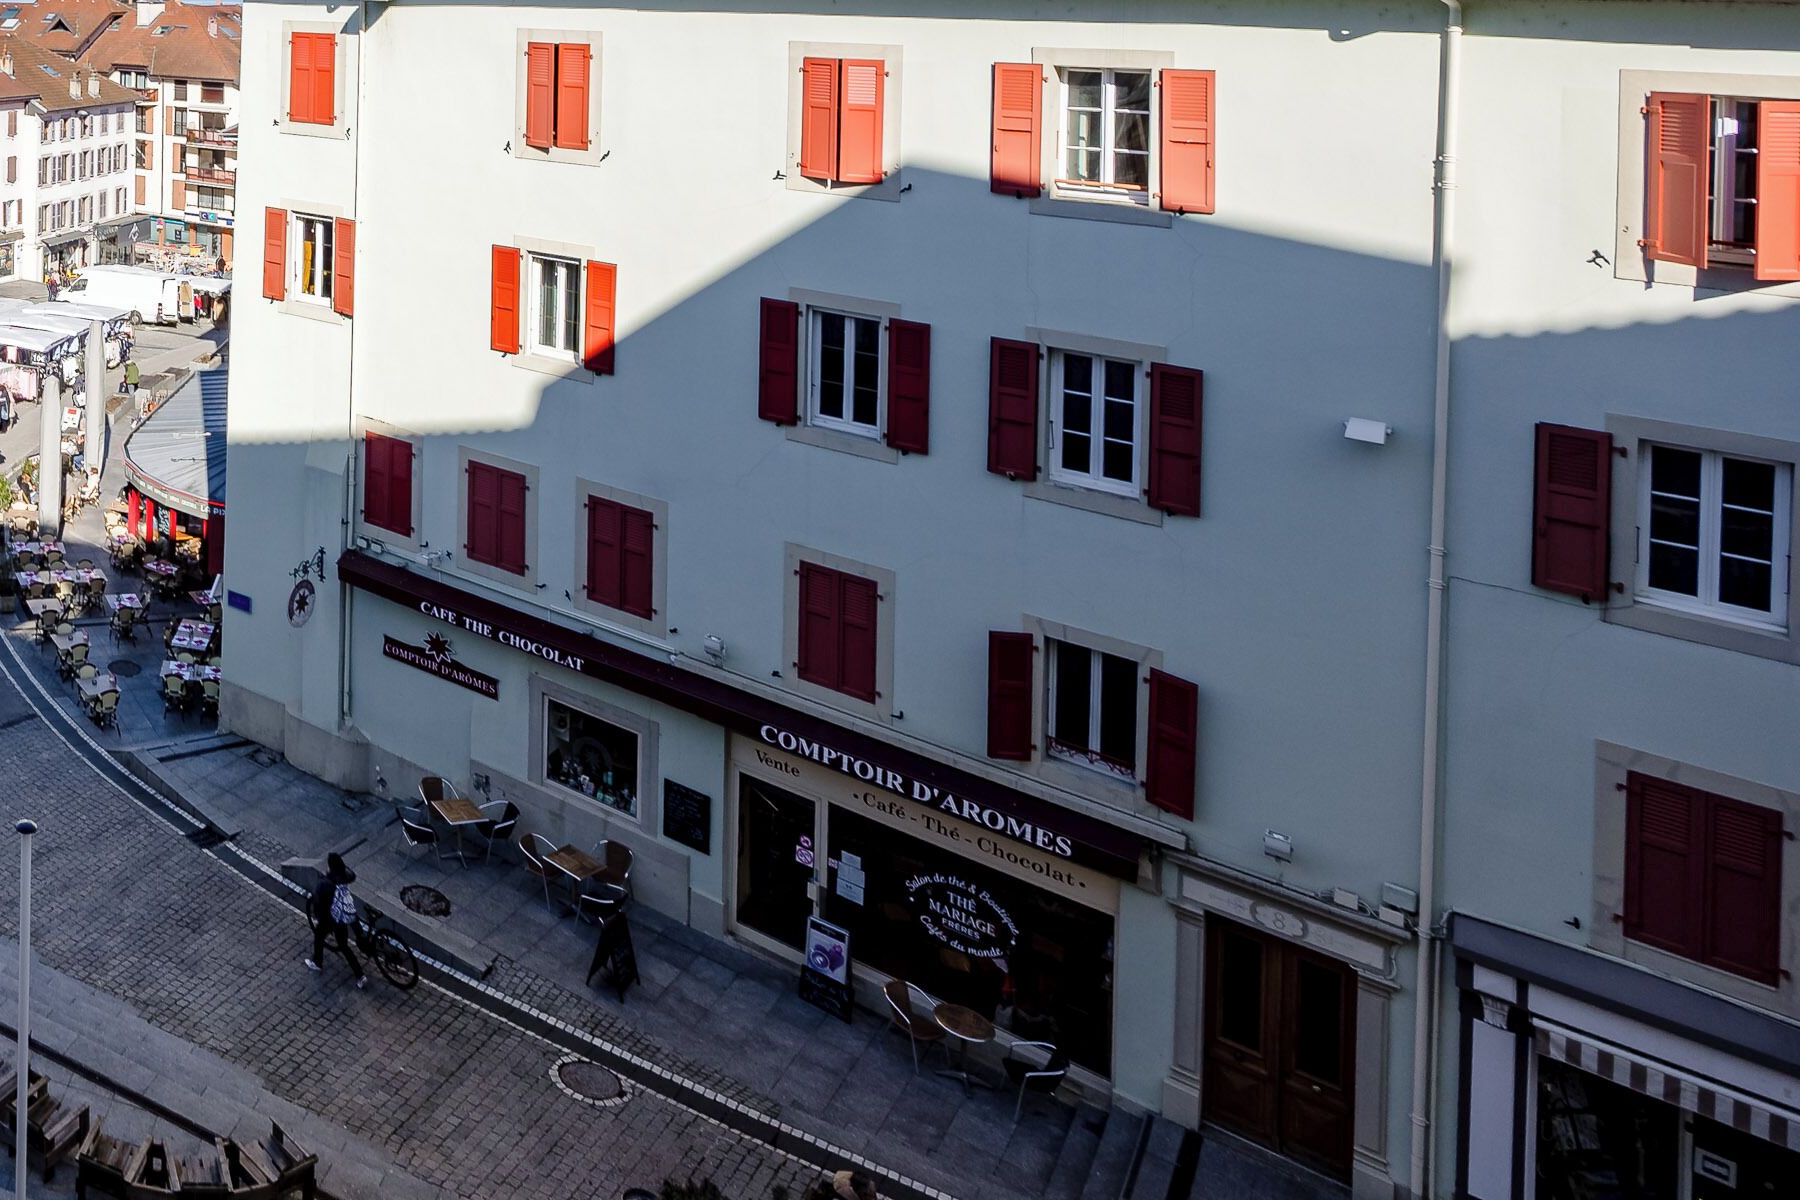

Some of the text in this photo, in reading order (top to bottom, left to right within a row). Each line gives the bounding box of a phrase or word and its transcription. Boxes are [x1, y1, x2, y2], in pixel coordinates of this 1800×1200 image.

[200, 504, 210, 513] LA
[419, 600, 585, 672] CAFE THE CHOCOLAT
[385, 642, 496, 694] COMPTOIR D'ARÔMES
[754, 749, 801, 778] Vente
[759, 723, 1074, 858] COMPTOIR D'AROMES
[863, 792, 906, 821] Café
[921, 813, 960, 841] Thé
[977, 837, 1076, 888] Chocolat
[905, 874, 933, 892] Salon
[933, 872, 947, 884] de
[978, 889, 1020, 935] Boutique
[929, 897, 997, 938] MARIAGE
[1272, 912, 1286, 929] 8
[919, 914, 1003, 958] Cafés du monde
